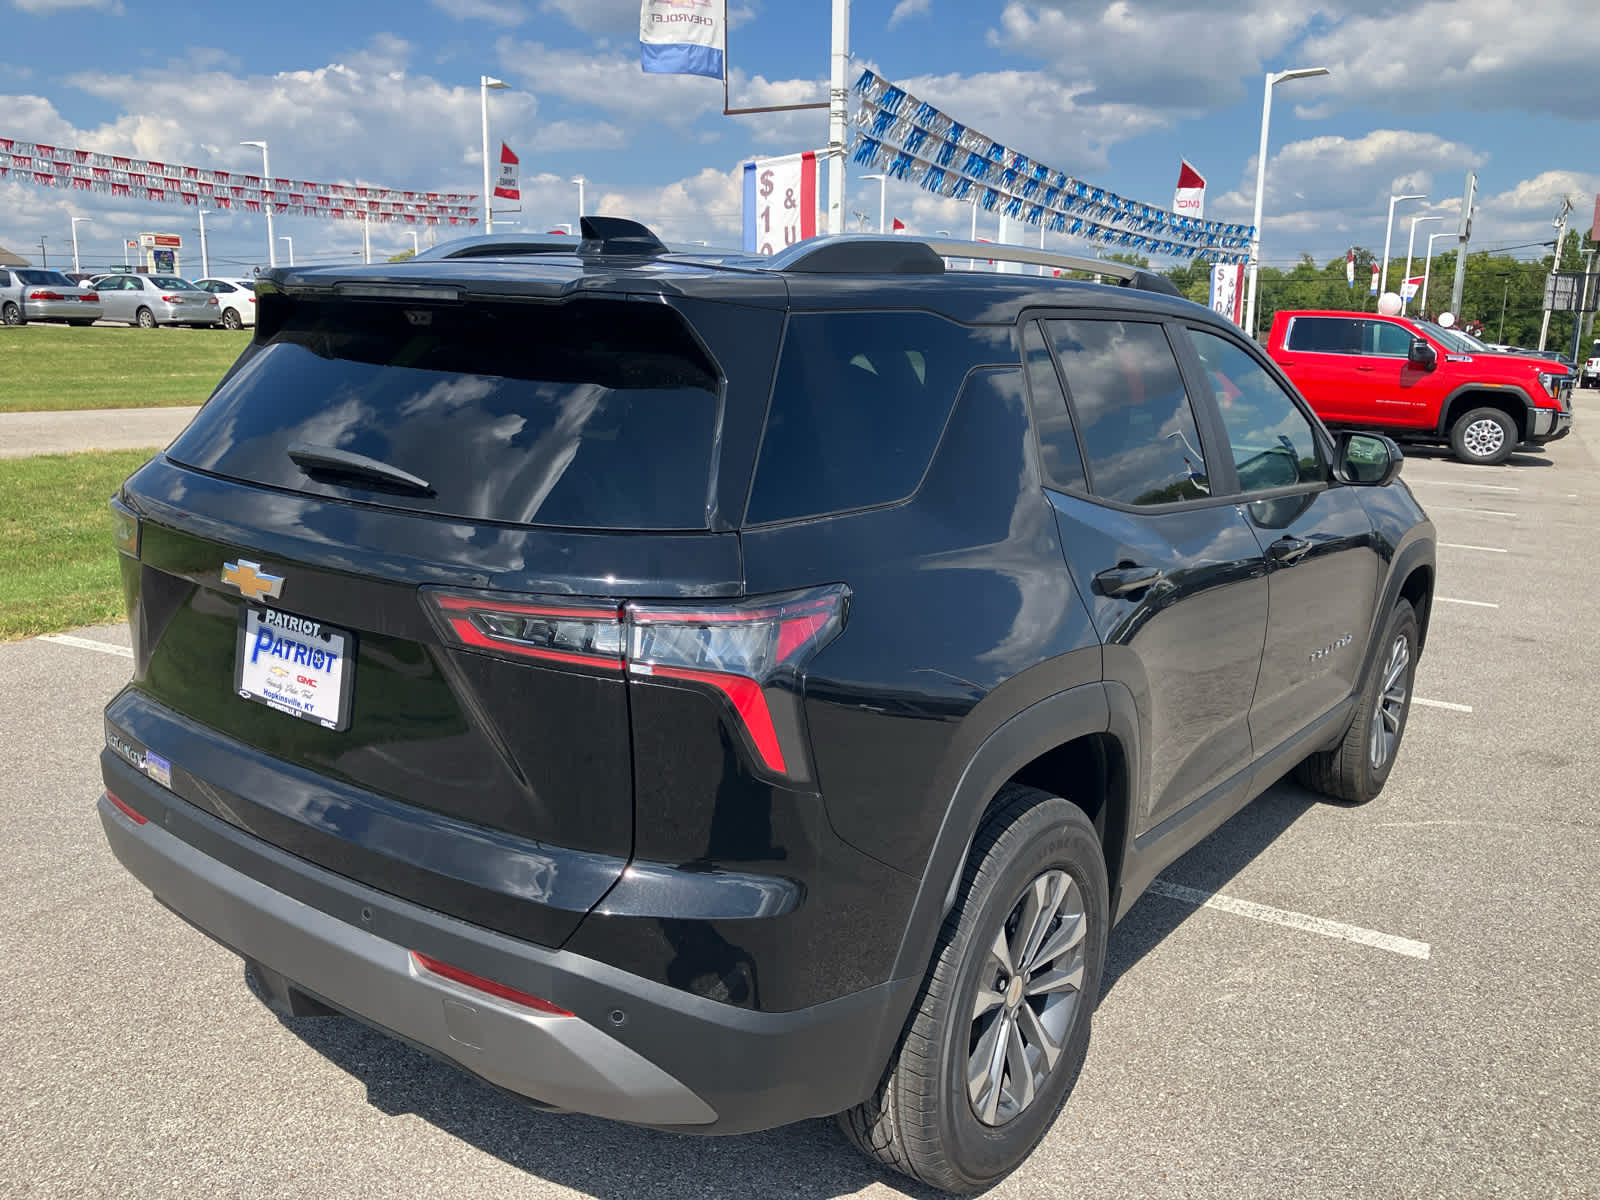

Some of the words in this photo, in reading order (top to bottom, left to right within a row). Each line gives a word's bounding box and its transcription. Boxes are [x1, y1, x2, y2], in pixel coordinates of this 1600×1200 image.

[784, 188, 796, 210] &
[265, 609, 321, 637] PATRIOT
[251, 625, 338, 673] PATRIOT
[296, 675, 318, 688] GMC
[263, 688, 303, 709] Hopkinsville,
[304, 702, 315, 713] KY
